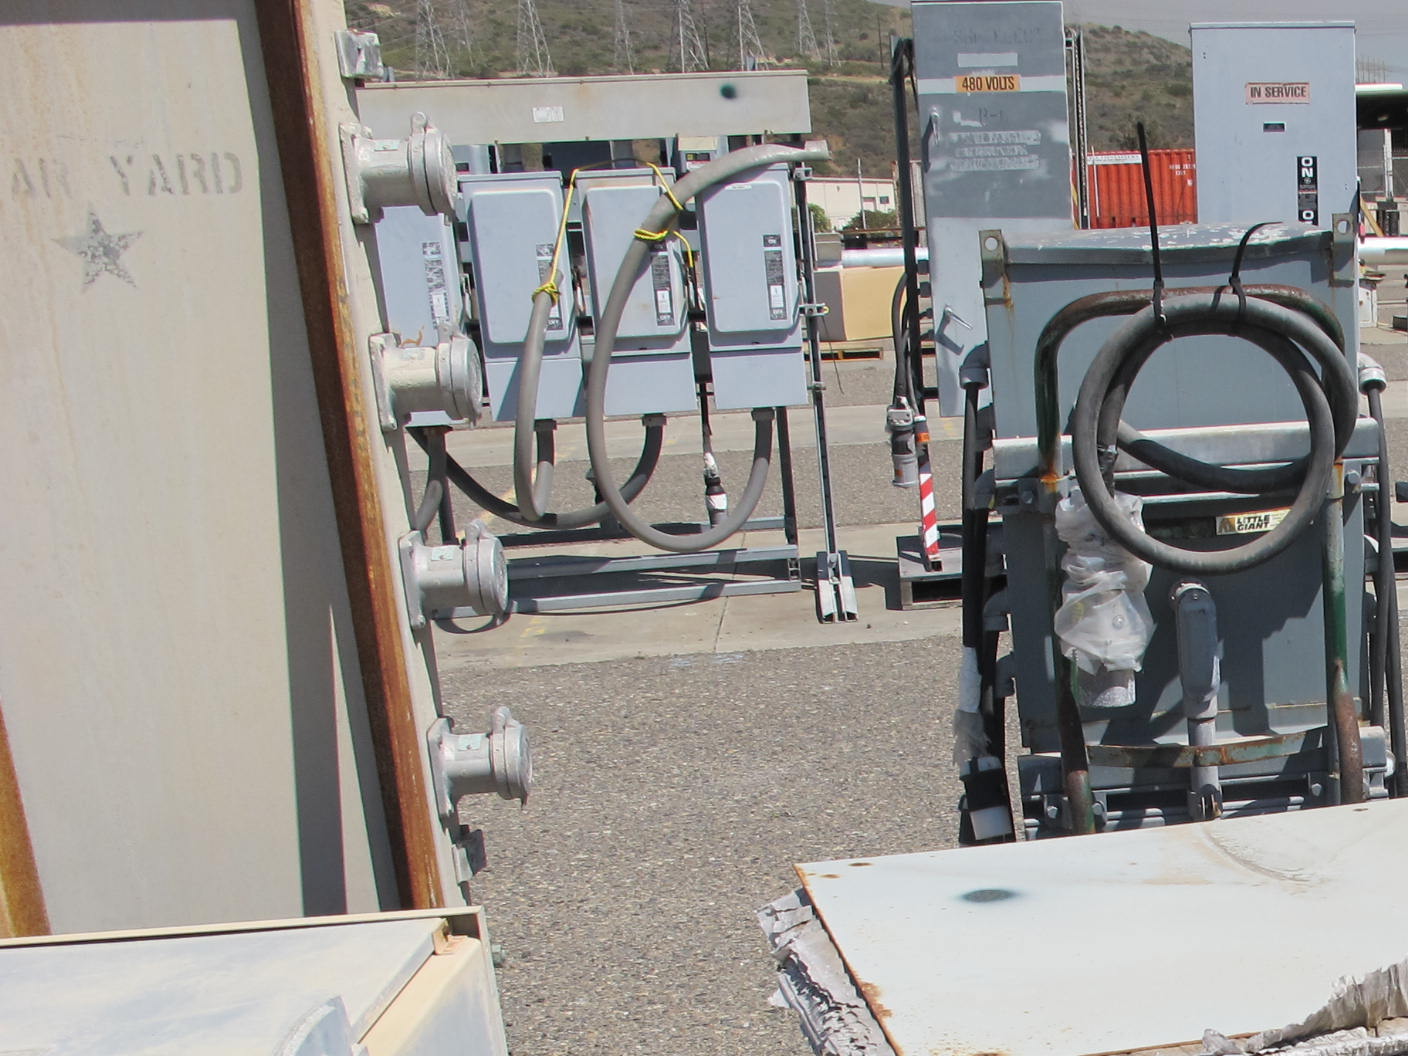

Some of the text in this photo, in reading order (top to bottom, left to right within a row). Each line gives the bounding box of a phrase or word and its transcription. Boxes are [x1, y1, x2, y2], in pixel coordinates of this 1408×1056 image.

[962, 75, 1016, 92] 480 VOLTS
[1250, 86, 1307, 99] IN SERVICE
[110, 151, 243, 196] YARD
[1301, 156, 1314, 178] ON
[1236, 514, 1271, 524] LITTLE
[1237, 522, 1269, 532] GIANT
